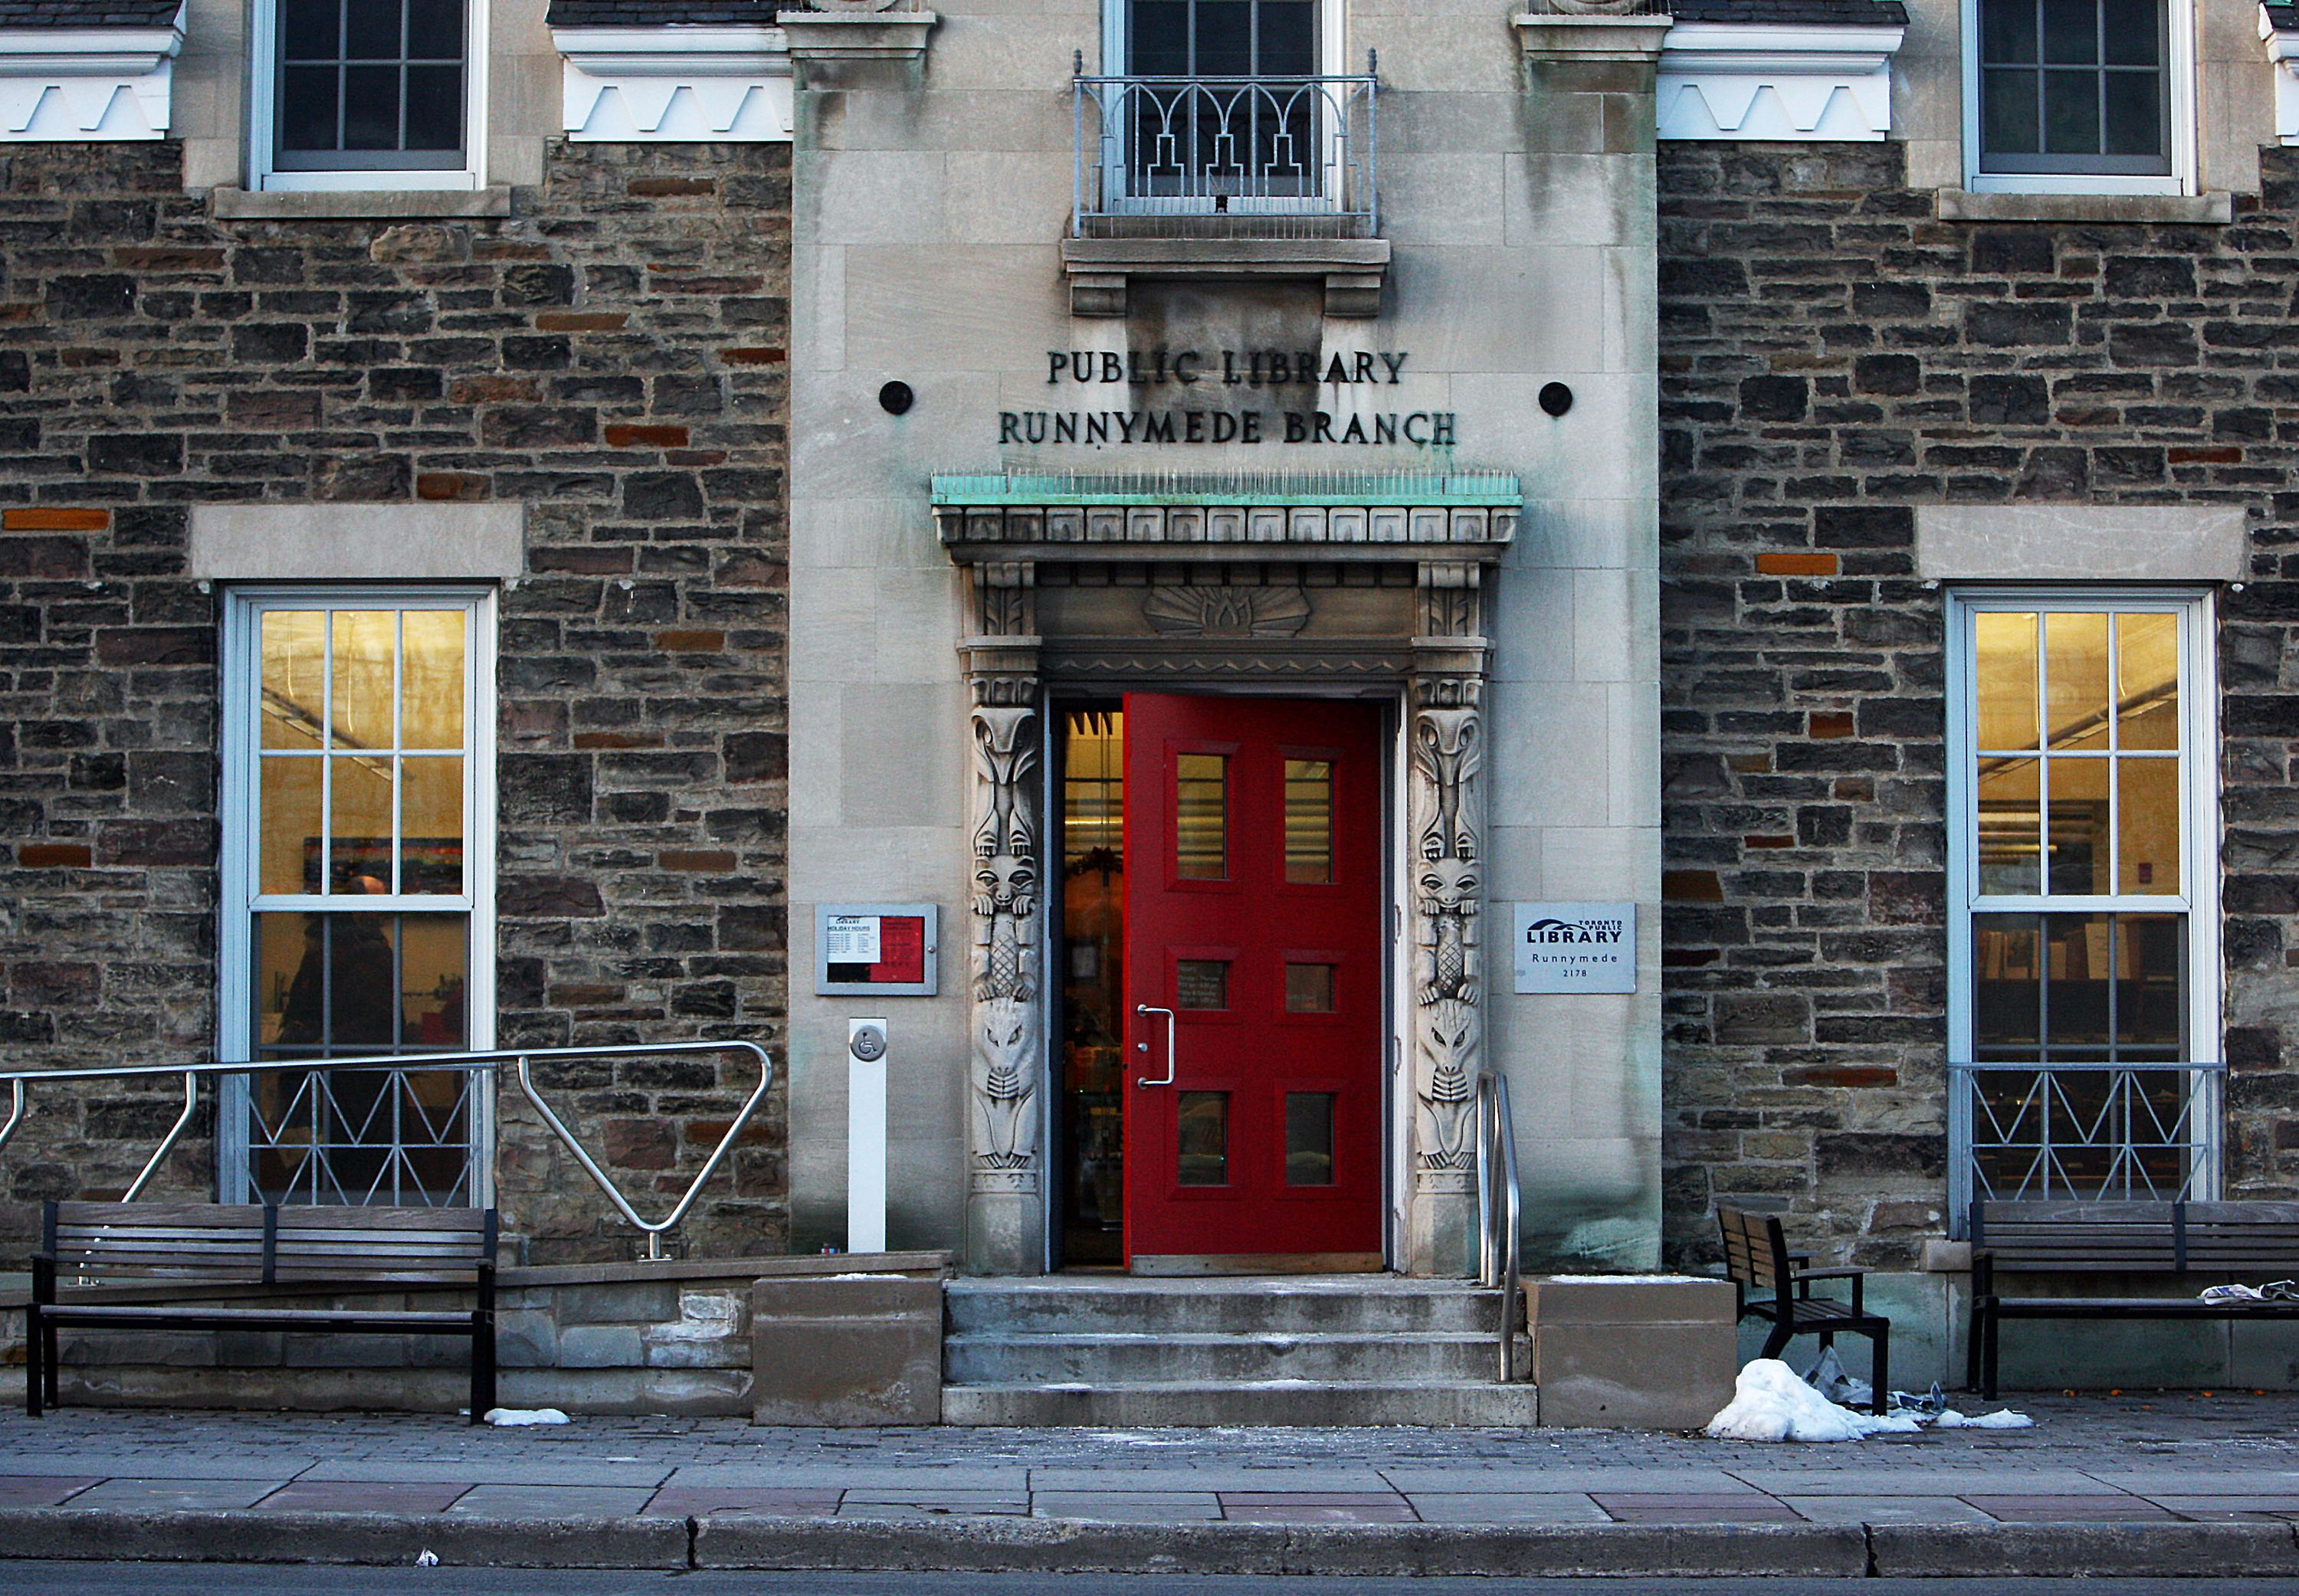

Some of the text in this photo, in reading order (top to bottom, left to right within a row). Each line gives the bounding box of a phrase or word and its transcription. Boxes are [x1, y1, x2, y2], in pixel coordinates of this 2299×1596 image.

[1047, 350, 1408, 384] PUBLIC LIBRARY
[998, 411, 1457, 445] RUNNYMEDE BRANCH
[1527, 931, 1622, 943] LIBRARY
[1533, 954, 1618, 965] Runnymede
